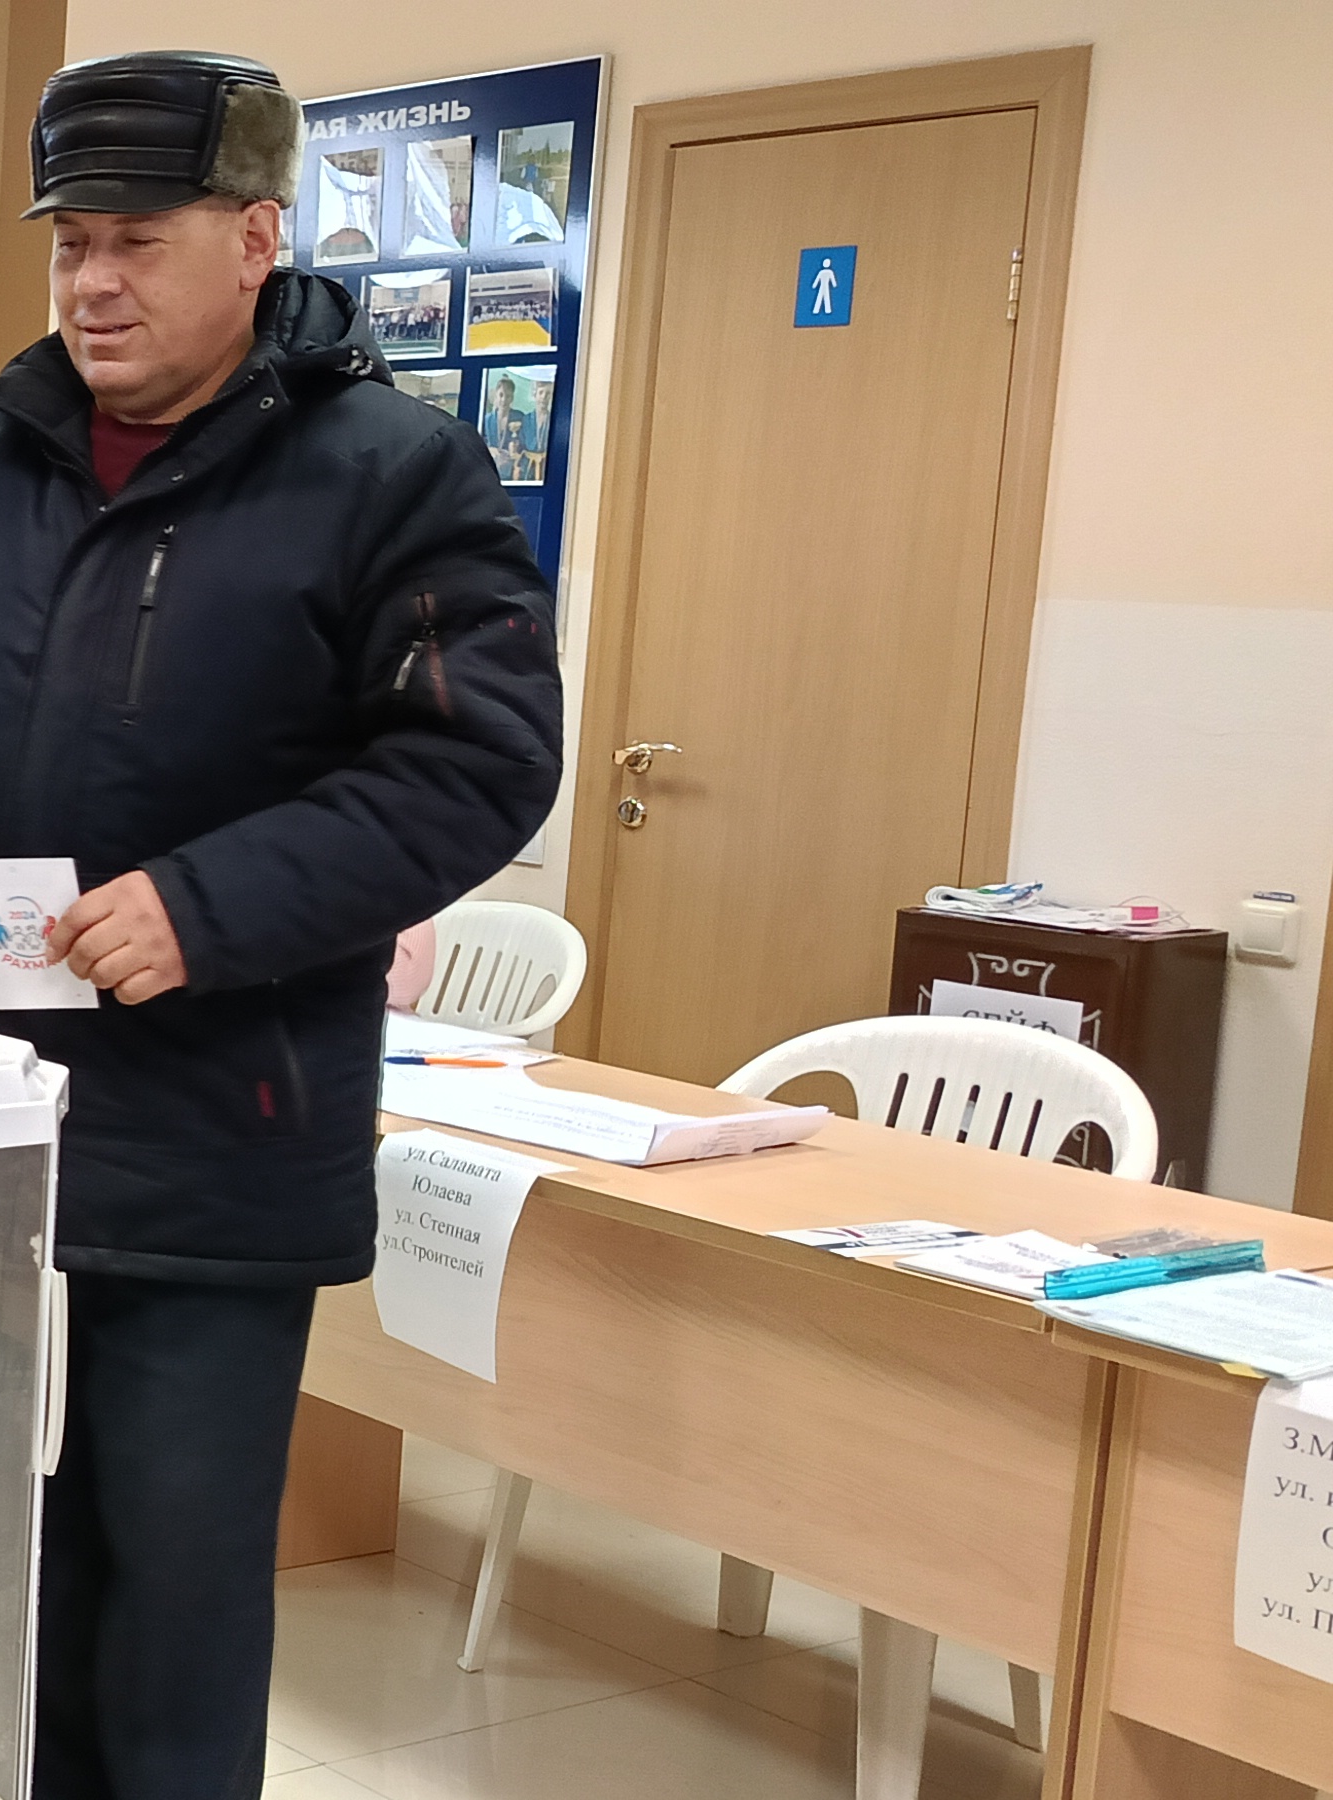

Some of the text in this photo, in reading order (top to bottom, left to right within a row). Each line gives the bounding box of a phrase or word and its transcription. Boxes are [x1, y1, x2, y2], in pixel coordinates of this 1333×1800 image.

[355, 100, 472, 136] ЖИЗНЬ
[8, 911, 37, 920] 2024
[403, 1146, 502, 1183] ул.Салавата
[411, 1174, 473, 1206] Юлаева
[393, 1208, 481, 1245] ул. Степная
[382, 1234, 484, 1278] ул.Строителей
[1274, 1476, 1315, 1502] ул.
[1261, 1597, 1301, 1623] ул.
